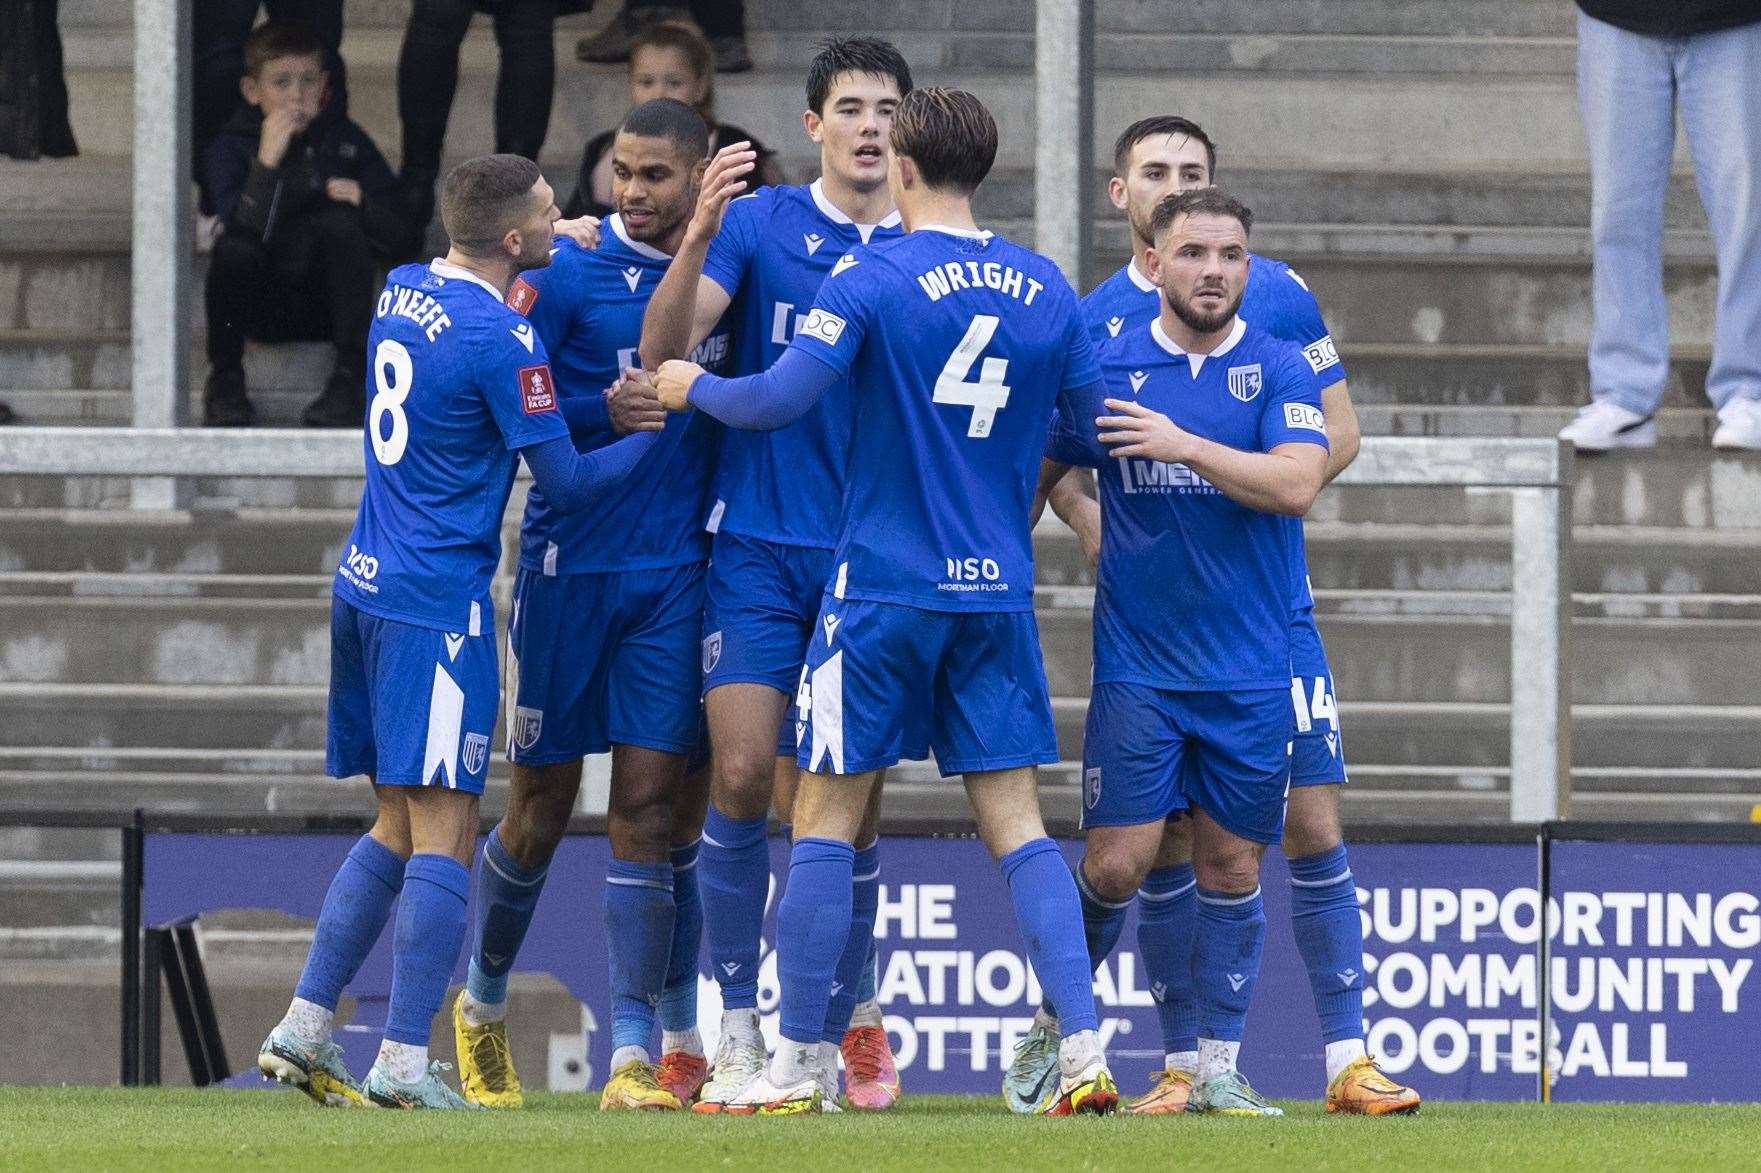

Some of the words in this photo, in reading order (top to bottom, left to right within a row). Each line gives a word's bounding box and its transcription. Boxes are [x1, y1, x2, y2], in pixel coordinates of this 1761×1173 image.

[916, 261, 1044, 306] WRIGHT
[377, 284, 451, 343] O'KEEFE
[369, 339, 413, 466] 8
[932, 314, 1011, 438] 4
[1290, 676, 1338, 733] 14
[873, 884, 958, 939] HE
[874, 950, 1155, 1007] ATIOAL
[1362, 1016, 1688, 1078] OOTBALL
